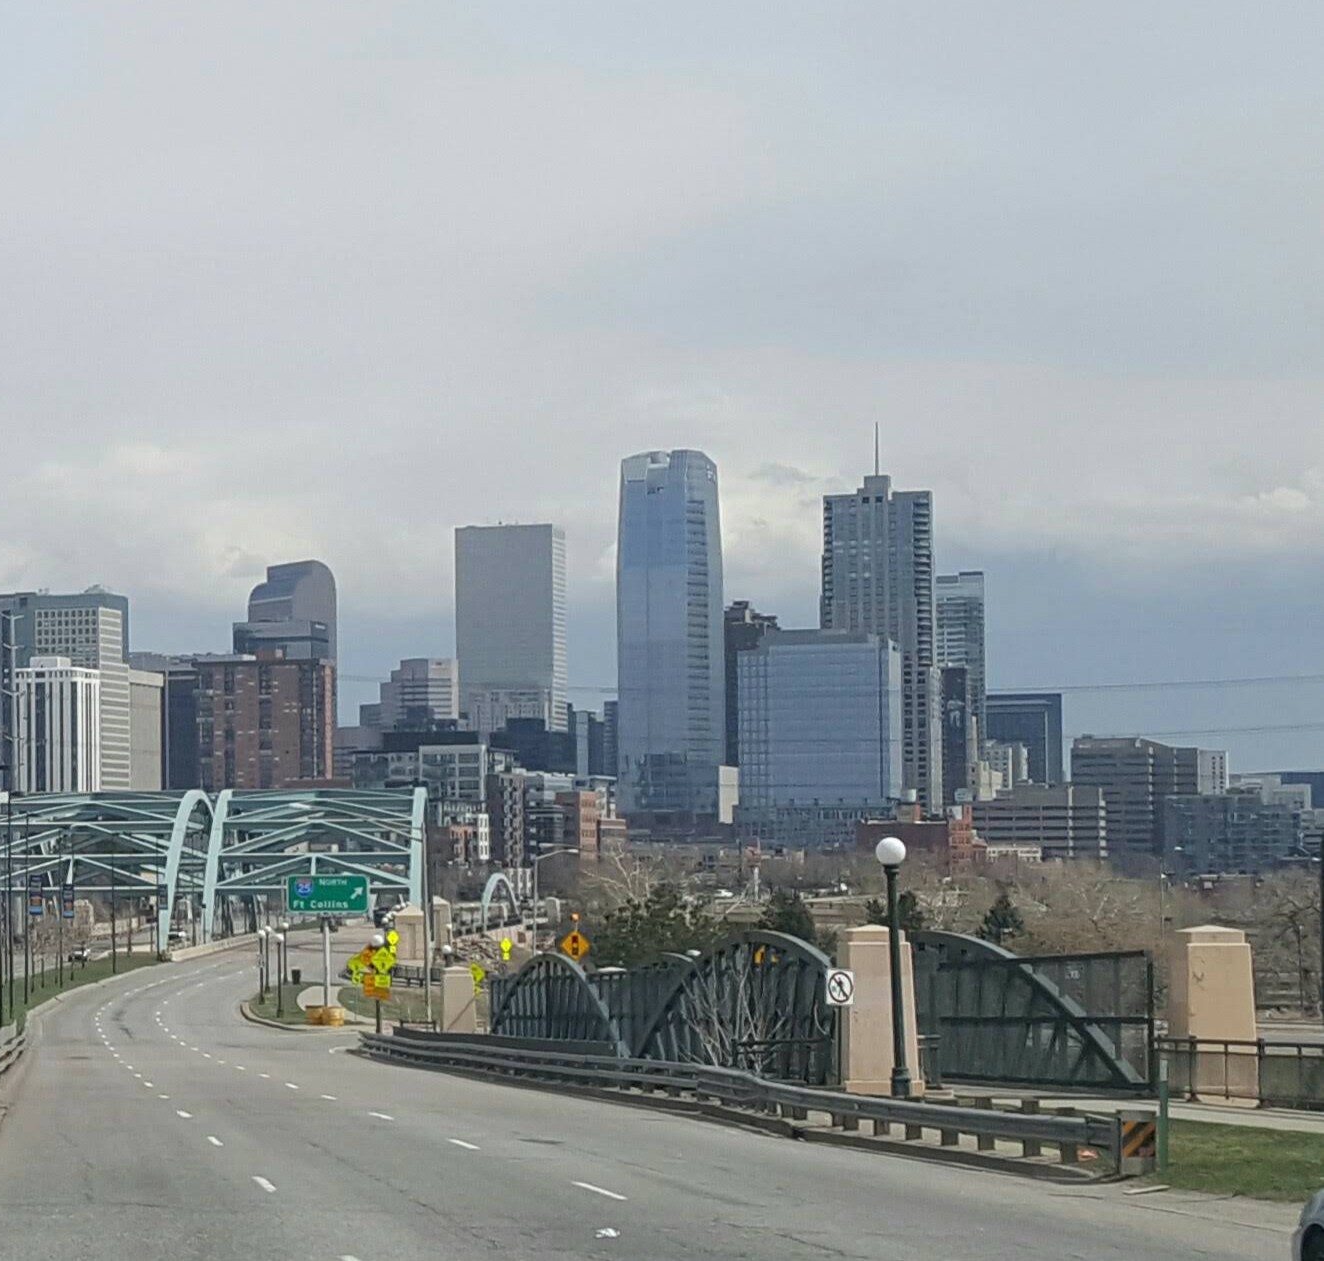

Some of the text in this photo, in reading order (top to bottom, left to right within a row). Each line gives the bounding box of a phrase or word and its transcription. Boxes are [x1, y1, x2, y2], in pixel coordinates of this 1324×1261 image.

[319, 878, 347, 886] NORTH
[298, 883, 312, 893] 25
[293, 899, 349, 909] Ft Collins
